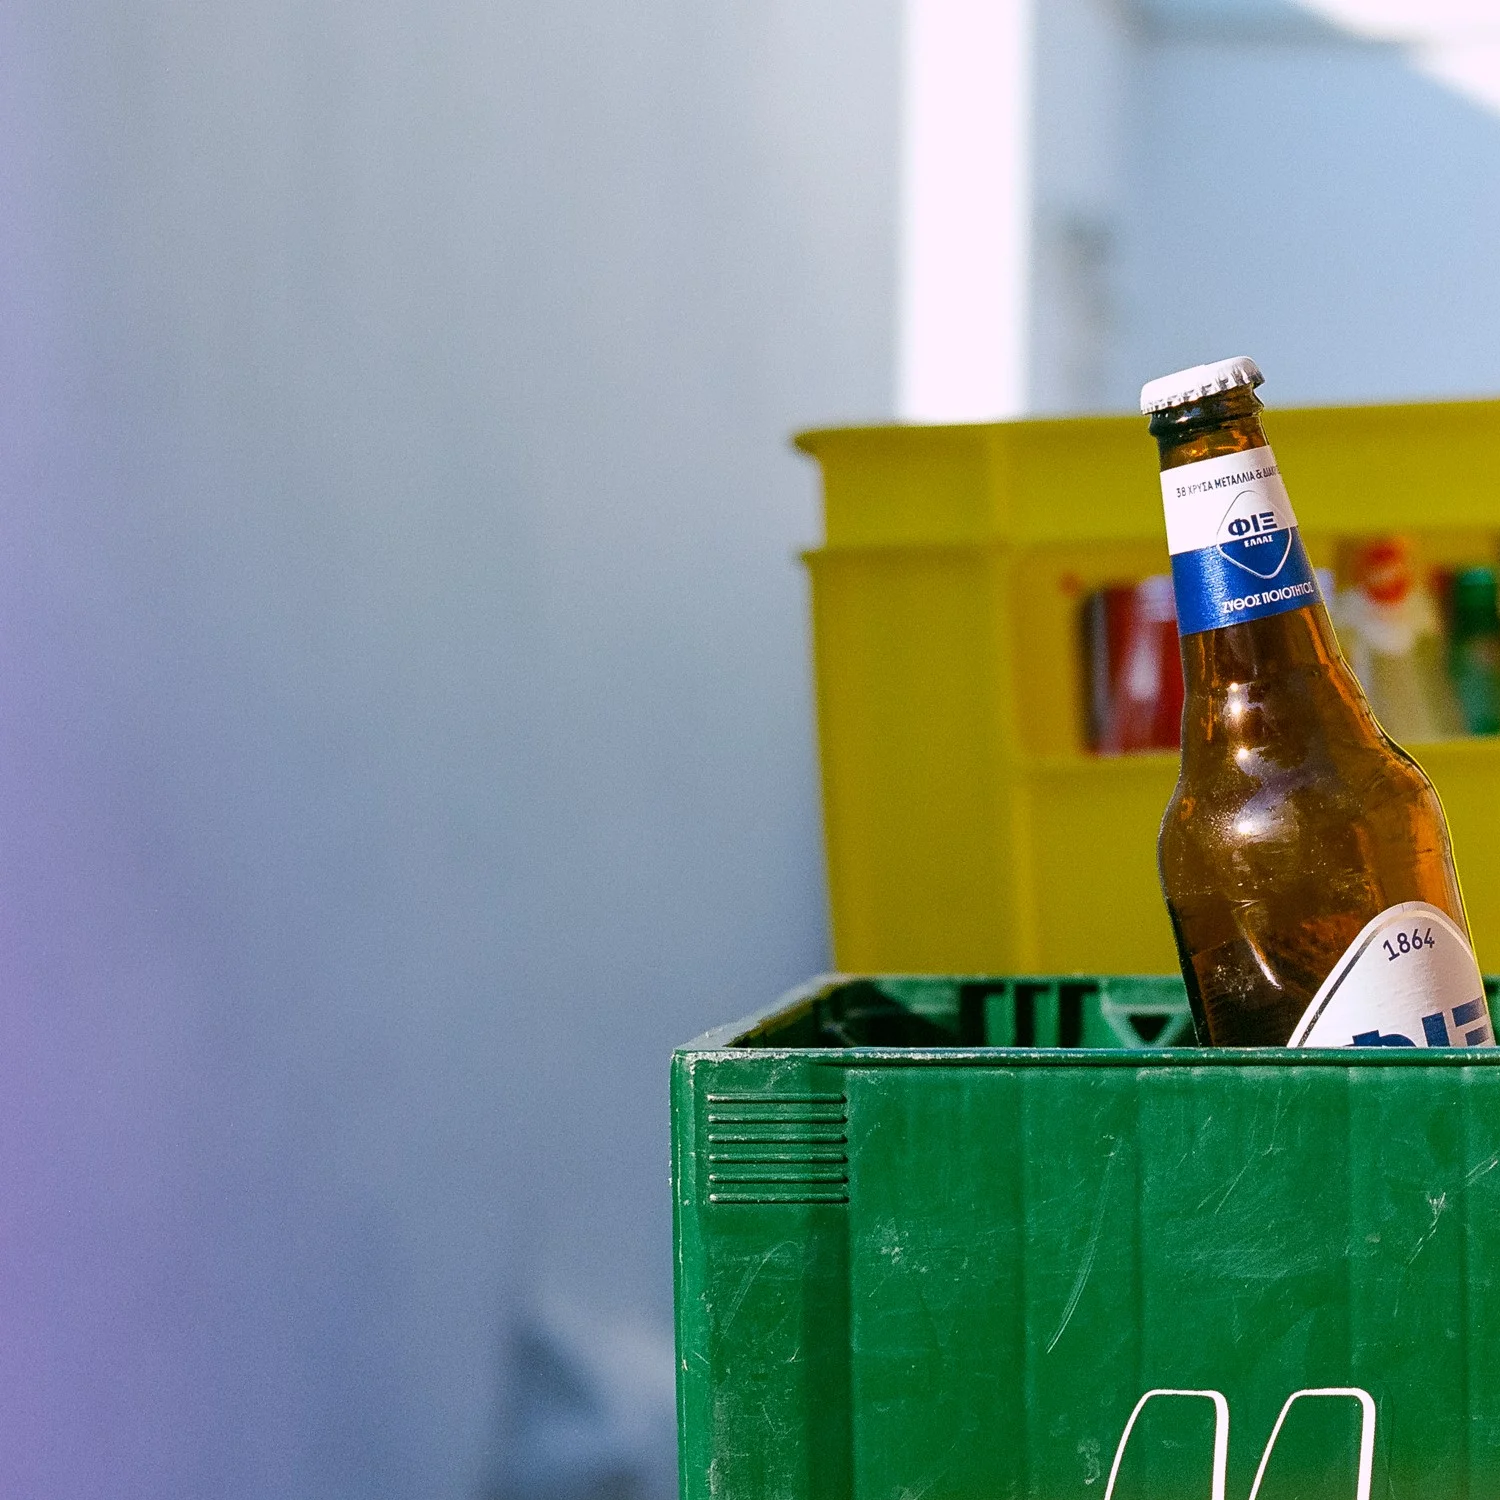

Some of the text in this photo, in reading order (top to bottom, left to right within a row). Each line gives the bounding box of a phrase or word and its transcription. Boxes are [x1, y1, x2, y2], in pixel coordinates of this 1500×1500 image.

[1176, 487, 1187, 498] 38
[1188, 481, 1214, 495] ΧΡΥΣΑ
[1214, 471, 1255, 489] ΜΕΤΑΛΛΙΑ
[1255, 469, 1263, 479] &
[1228, 511, 1278, 536] ΦΙΞ
[1243, 535, 1274, 548] ΕΛΛΑΣ
[1221, 581, 1315, 613] ΖΥΘΟΣ ΠΟΙΟΤΗΤΟΣ
[1382, 927, 1435, 962] 1864
